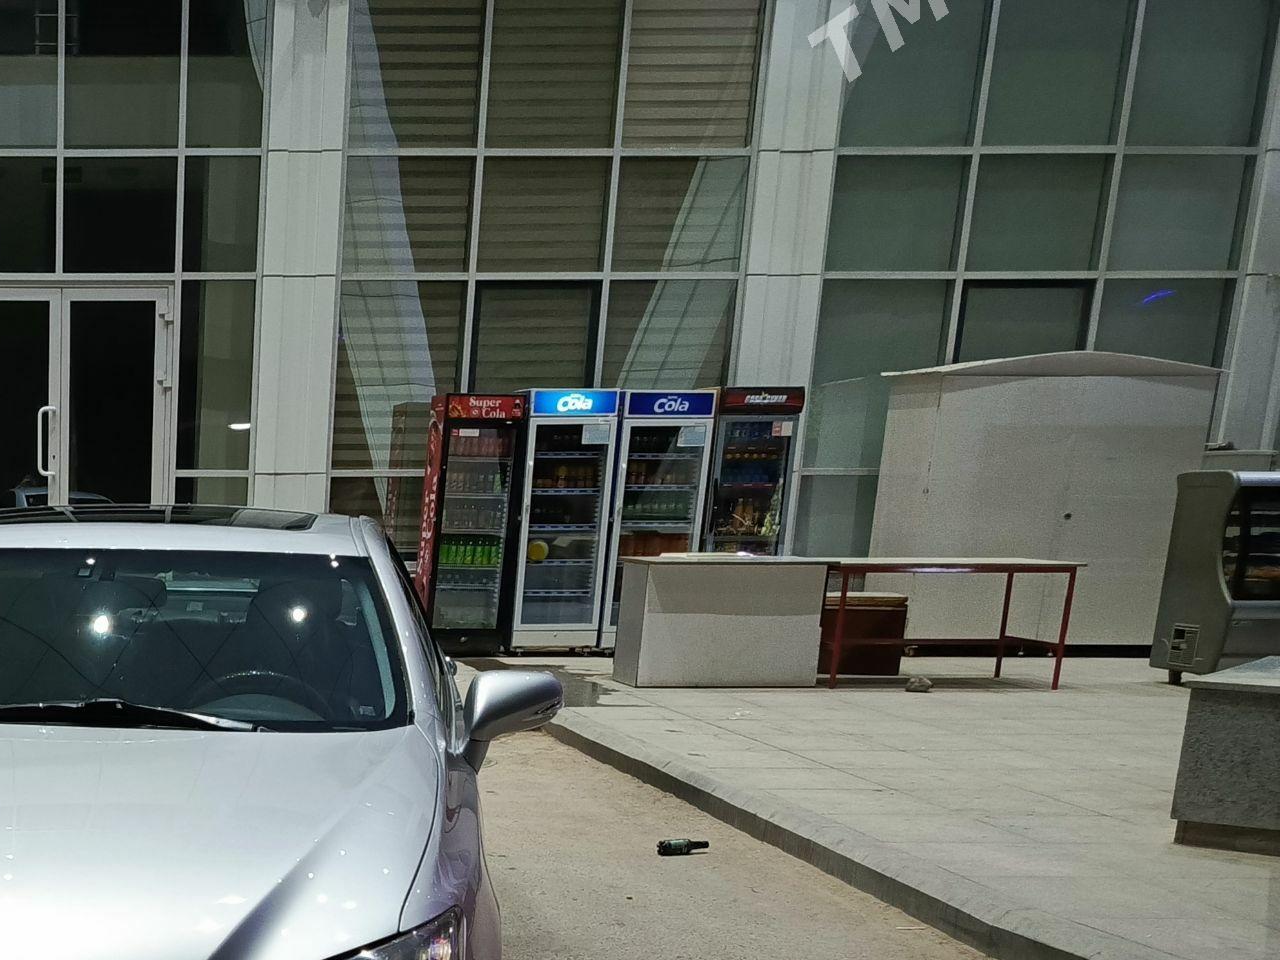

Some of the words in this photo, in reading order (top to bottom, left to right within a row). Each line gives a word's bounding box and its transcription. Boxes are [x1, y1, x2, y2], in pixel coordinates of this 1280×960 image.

[469, 396, 502, 408] Super
[557, 394, 593, 412] Cola
[653, 397, 690, 413] Cola
[482, 408, 506, 418] Cola
